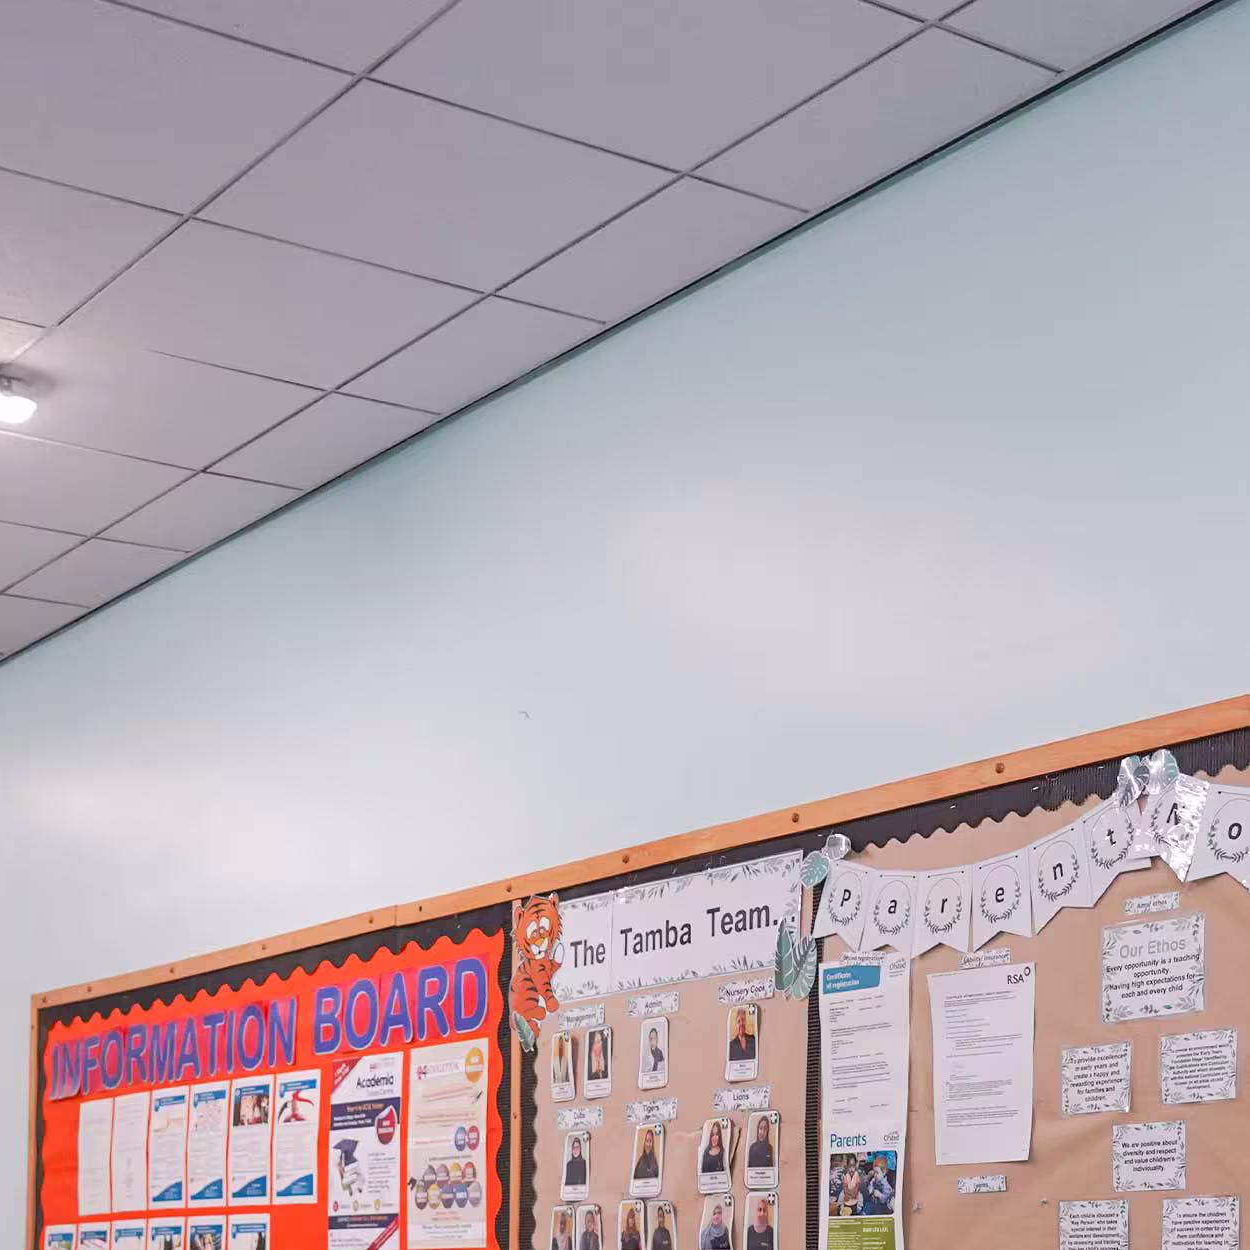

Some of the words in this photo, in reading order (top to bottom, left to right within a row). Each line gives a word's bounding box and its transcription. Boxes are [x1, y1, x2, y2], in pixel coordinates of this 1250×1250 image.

[570, 939, 606, 968] The
[620, 919, 692, 956] Tamba
[1120, 945, 1144, 959] Our
[1148, 939, 1187, 955] Ethos
[1106, 965, 1123, 973] Every
[1125, 960, 1159, 970] opportunity
[1174, 953, 1200, 962] teaching
[1007, 974, 1025, 985] RSA
[1110, 983, 1130, 991] Having
[1132, 980, 1145, 989] high
[1146, 975, 1186, 986] expectations
[726, 985, 749, 997] Nursery
[750, 984, 766, 994] Cook
[1169, 984, 1183, 992] child
[50, 996, 299, 1098] INFORMATION
[313, 957, 488, 1055] BOARD
[733, 1093, 750, 1101] Lions
[643, 1104, 660, 1113] Tigers
[830, 1133, 867, 1149] Parents
